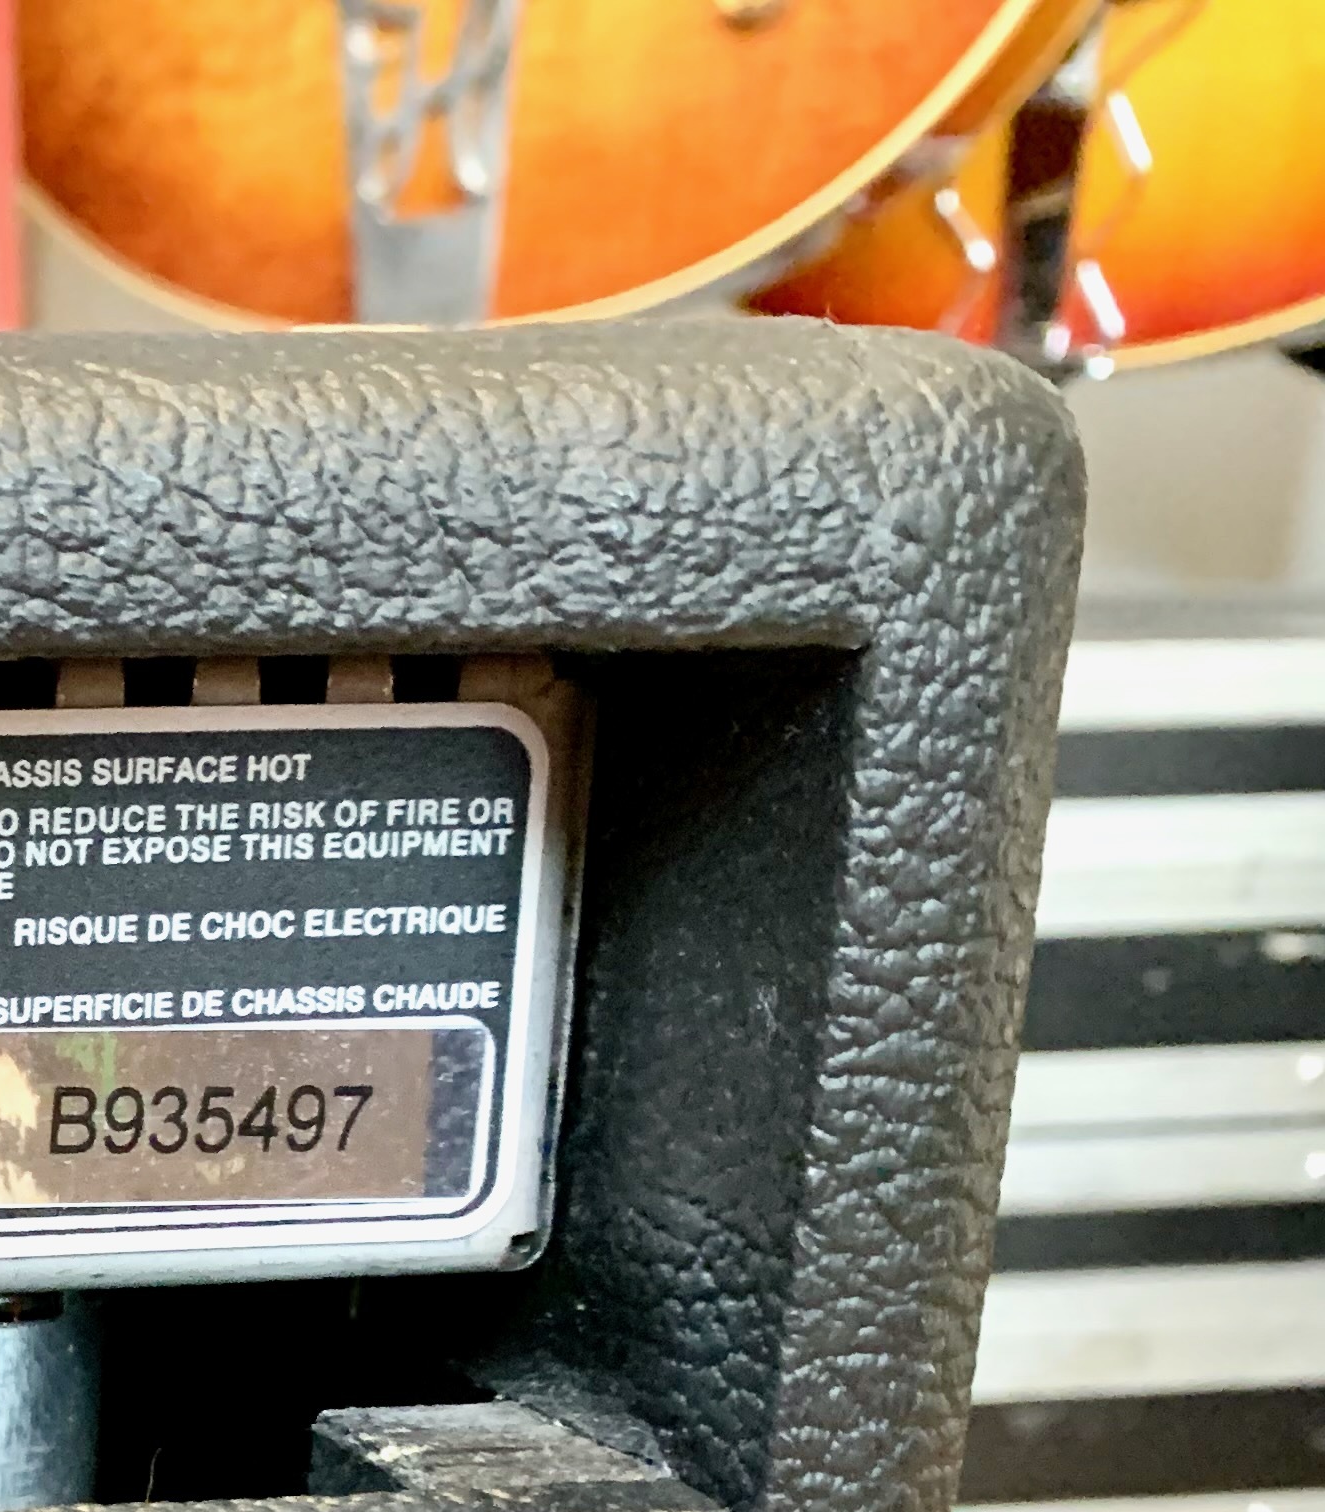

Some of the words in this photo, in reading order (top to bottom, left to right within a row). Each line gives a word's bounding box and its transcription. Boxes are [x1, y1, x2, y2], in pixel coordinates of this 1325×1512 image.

[92, 755, 238, 785] SURFACE
[247, 754, 311, 782] HOT
[29, 805, 166, 835] REDUCE
[175, 803, 239, 831] THE
[250, 801, 325, 829] RISK
[334, 800, 379, 828] OF
[387, 798, 460, 826] FIRE
[468, 798, 513, 825] OR
[25, 838, 93, 867] NOT
[102, 835, 231, 865] EXPOSE
[240, 833, 314, 860] THIS
[323, 828, 513, 859] EQUIPMENT
[14, 914, 138, 946] RISQUE
[148, 913, 192, 942] DE
[200, 910, 295, 940] CHOC
[304, 904, 506, 937] ELECTRIQUE
[182, 990, 225, 1017] DE
[232, 985, 365, 1016] CHASSIS
[373, 982, 499, 1012] CHAUDE
[49, 1084, 373, 1155] B935497
